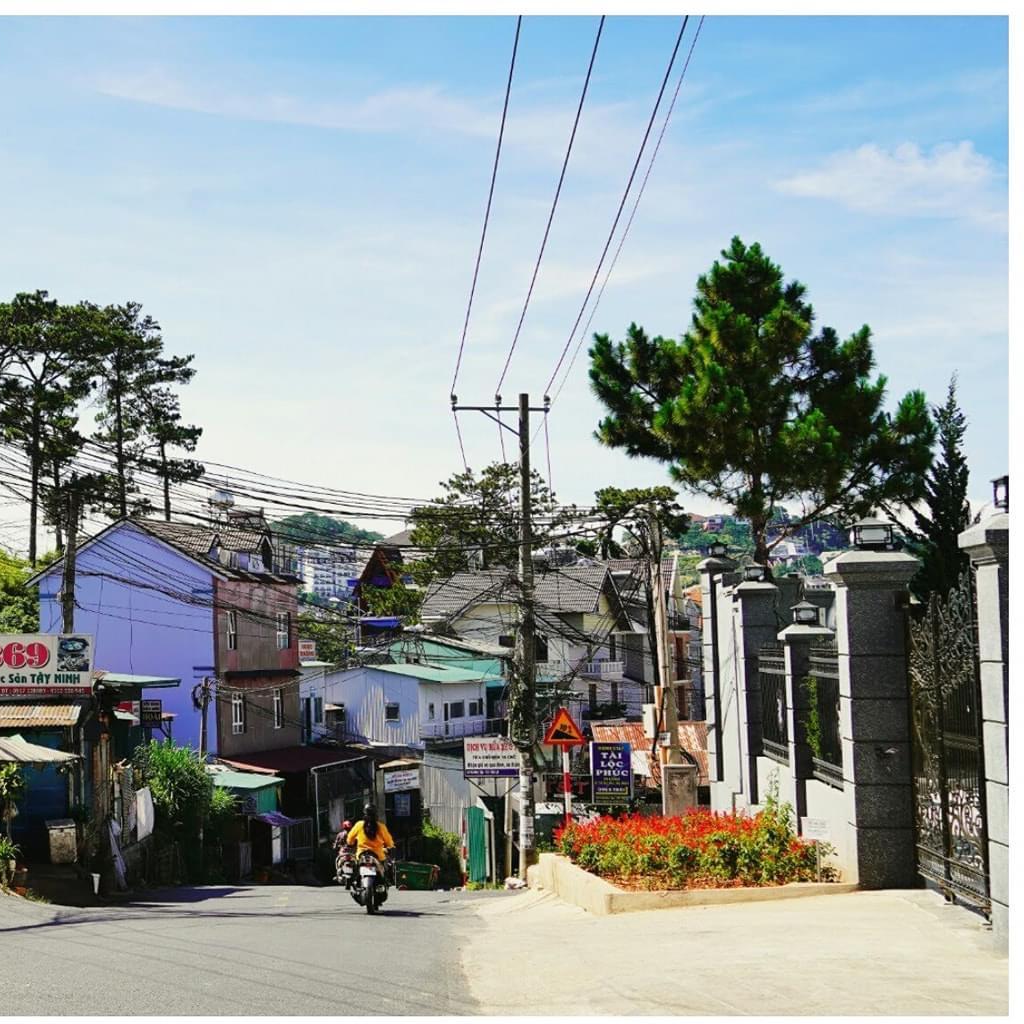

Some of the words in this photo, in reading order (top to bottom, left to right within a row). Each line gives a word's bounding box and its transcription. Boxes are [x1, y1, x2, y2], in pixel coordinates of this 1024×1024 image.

[8, 671, 27, 684] Sản
[30, 671, 53, 685] TÂY
[54, 673, 81, 684] NINH
[600, 750, 623, 760] TÀI
[600, 759, 624, 770] LỘC
[595, 767, 629, 777] PHÚC
